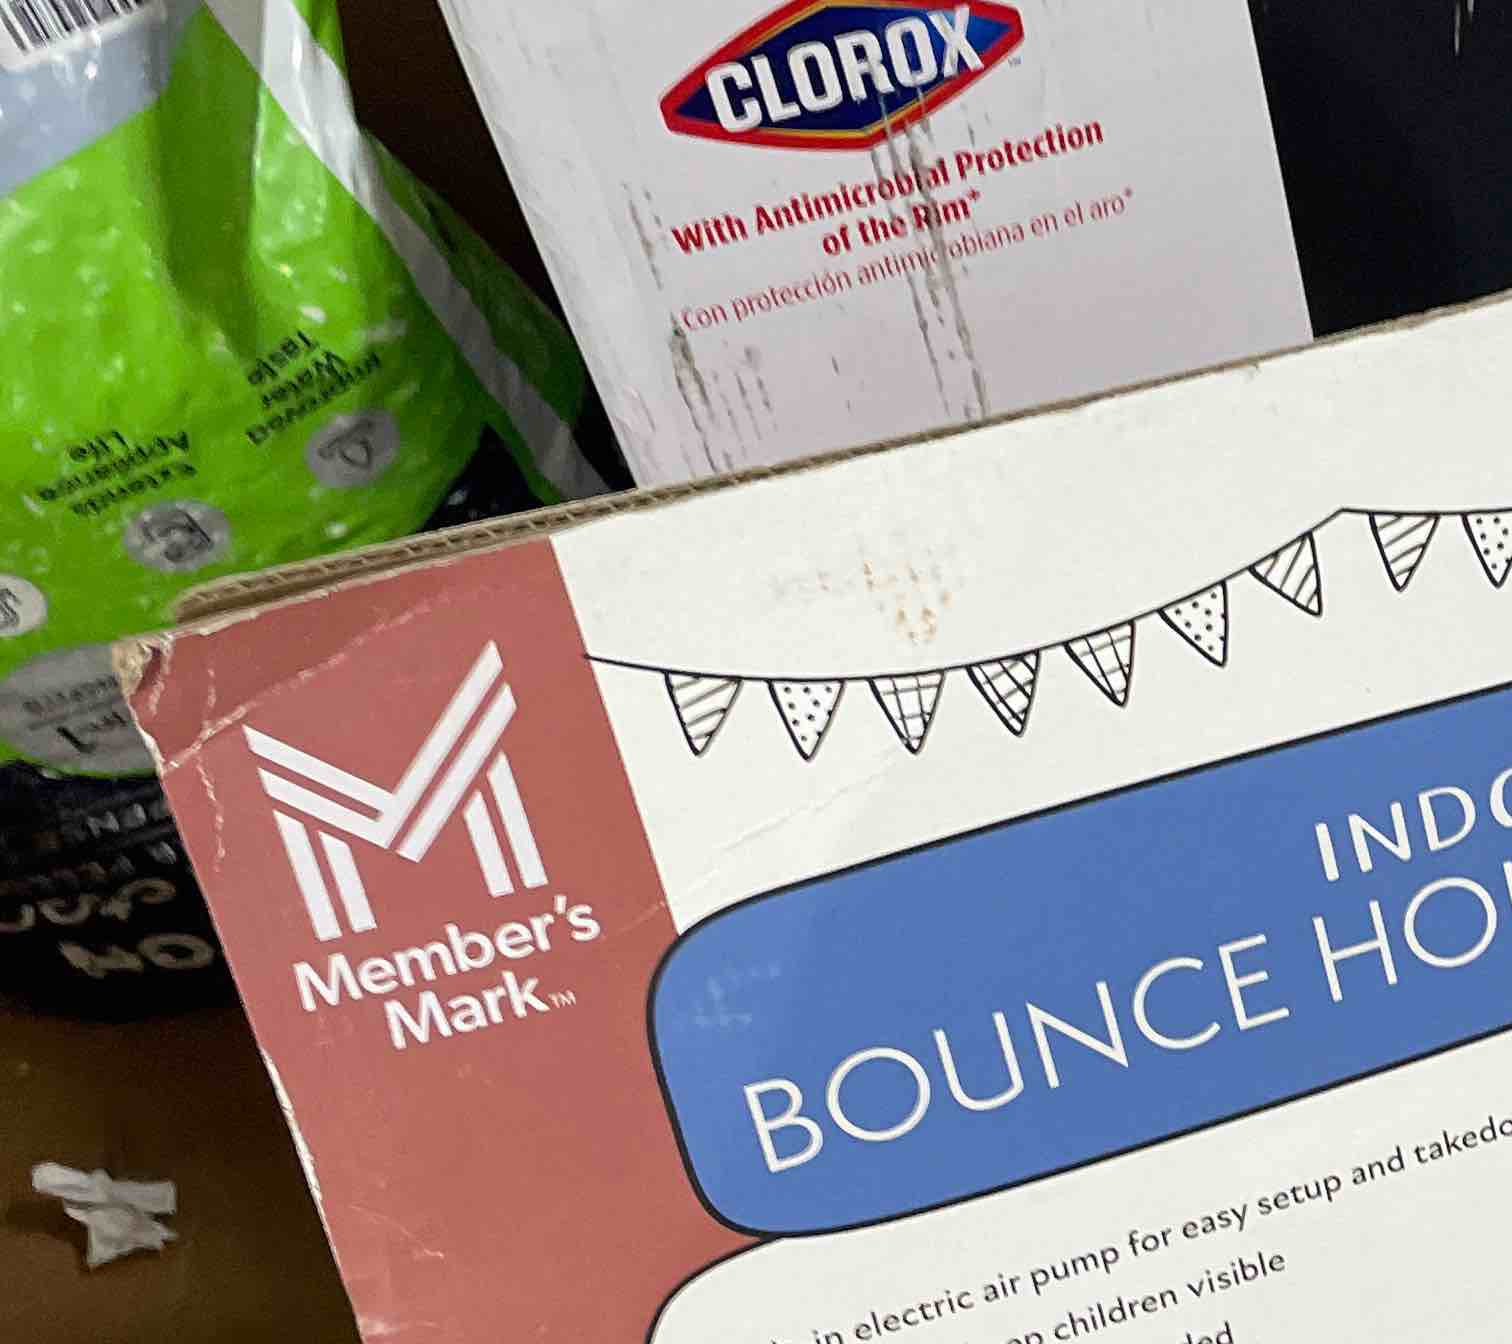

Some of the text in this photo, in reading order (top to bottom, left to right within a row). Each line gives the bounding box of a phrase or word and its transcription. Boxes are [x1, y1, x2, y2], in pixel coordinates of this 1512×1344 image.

[703, 4, 986, 134] CLOROX
[671, 118, 1104, 256] With Antimicrobial Protection
[820, 225, 854, 258] of
[859, 210, 908, 248] the
[679, 304, 730, 333] Con
[732, 270, 854, 326] protección
[855, 222, 1028, 292] antimicrobiana
[1030, 215, 1059, 237] en
[1062, 200, 1087, 229] el
[292, 893, 602, 1014] Member's
[740, 933, 1292, 1176] BOUNCE
[853, 1289, 976, 1342] electric
[982, 1274, 1022, 1304] air
[1029, 1245, 1121, 1297] pump
[1127, 1226, 1173, 1257] for
[1181, 1202, 1249, 1241] easy
[1256, 1174, 1343, 1217] setup
[1351, 1146, 1407, 1187] and
[1053, 1287, 1179, 1344] children
[1187, 1251, 1287, 1299] visible
